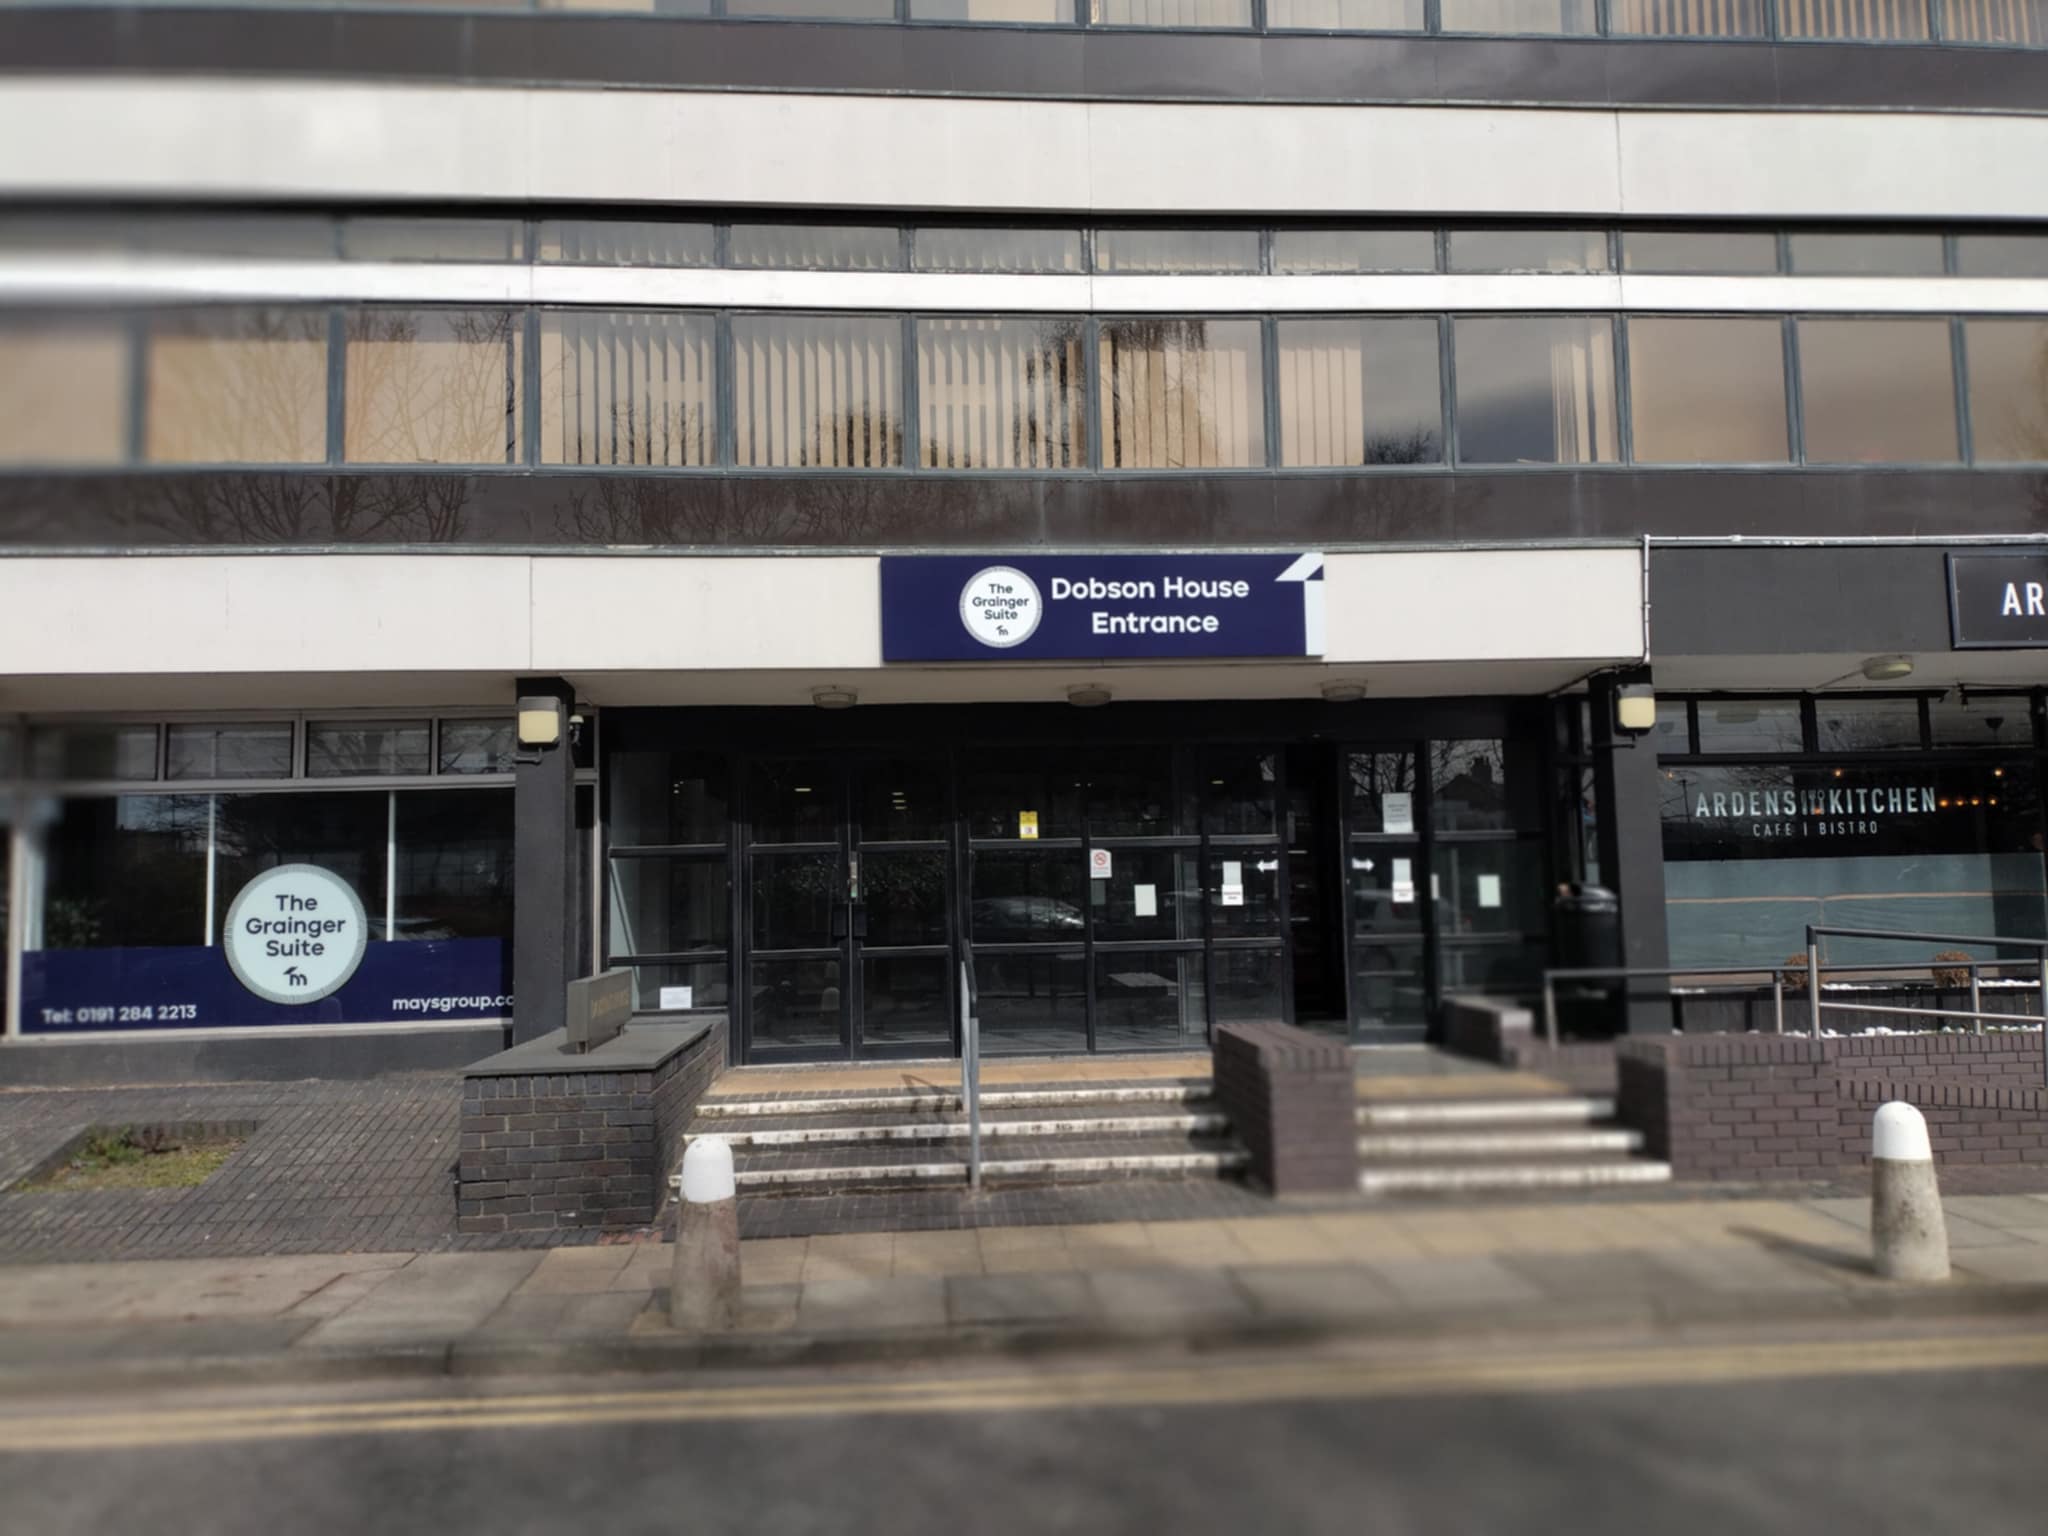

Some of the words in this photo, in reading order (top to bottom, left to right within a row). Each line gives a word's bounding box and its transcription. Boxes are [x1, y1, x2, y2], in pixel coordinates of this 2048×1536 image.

[988, 583, 1013, 594] The
[1051, 577, 1155, 600] Dobson
[1163, 576, 1250, 598] House
[972, 596, 1029, 609] Grainger
[2002, 582, 2046, 616] AR
[984, 609, 1018, 620] Suite
[1091, 611, 1219, 634] Entrance
[1695, 790, 1797, 817] ARDENS
[1829, 787, 1937, 814] KITCHEN
[1752, 822, 1793, 837] CAFE
[1819, 820, 1878, 835] BISTRO
[275, 894, 319, 912] The
[245, 916, 346, 939] Grainger
[266, 939, 325, 957] Suite
[42, 1008, 72, 1023] Tel:
[76, 1007, 115, 1022] 0191
[119, 1006, 152, 1021] 284
[158, 1004, 198, 1020] 2213
